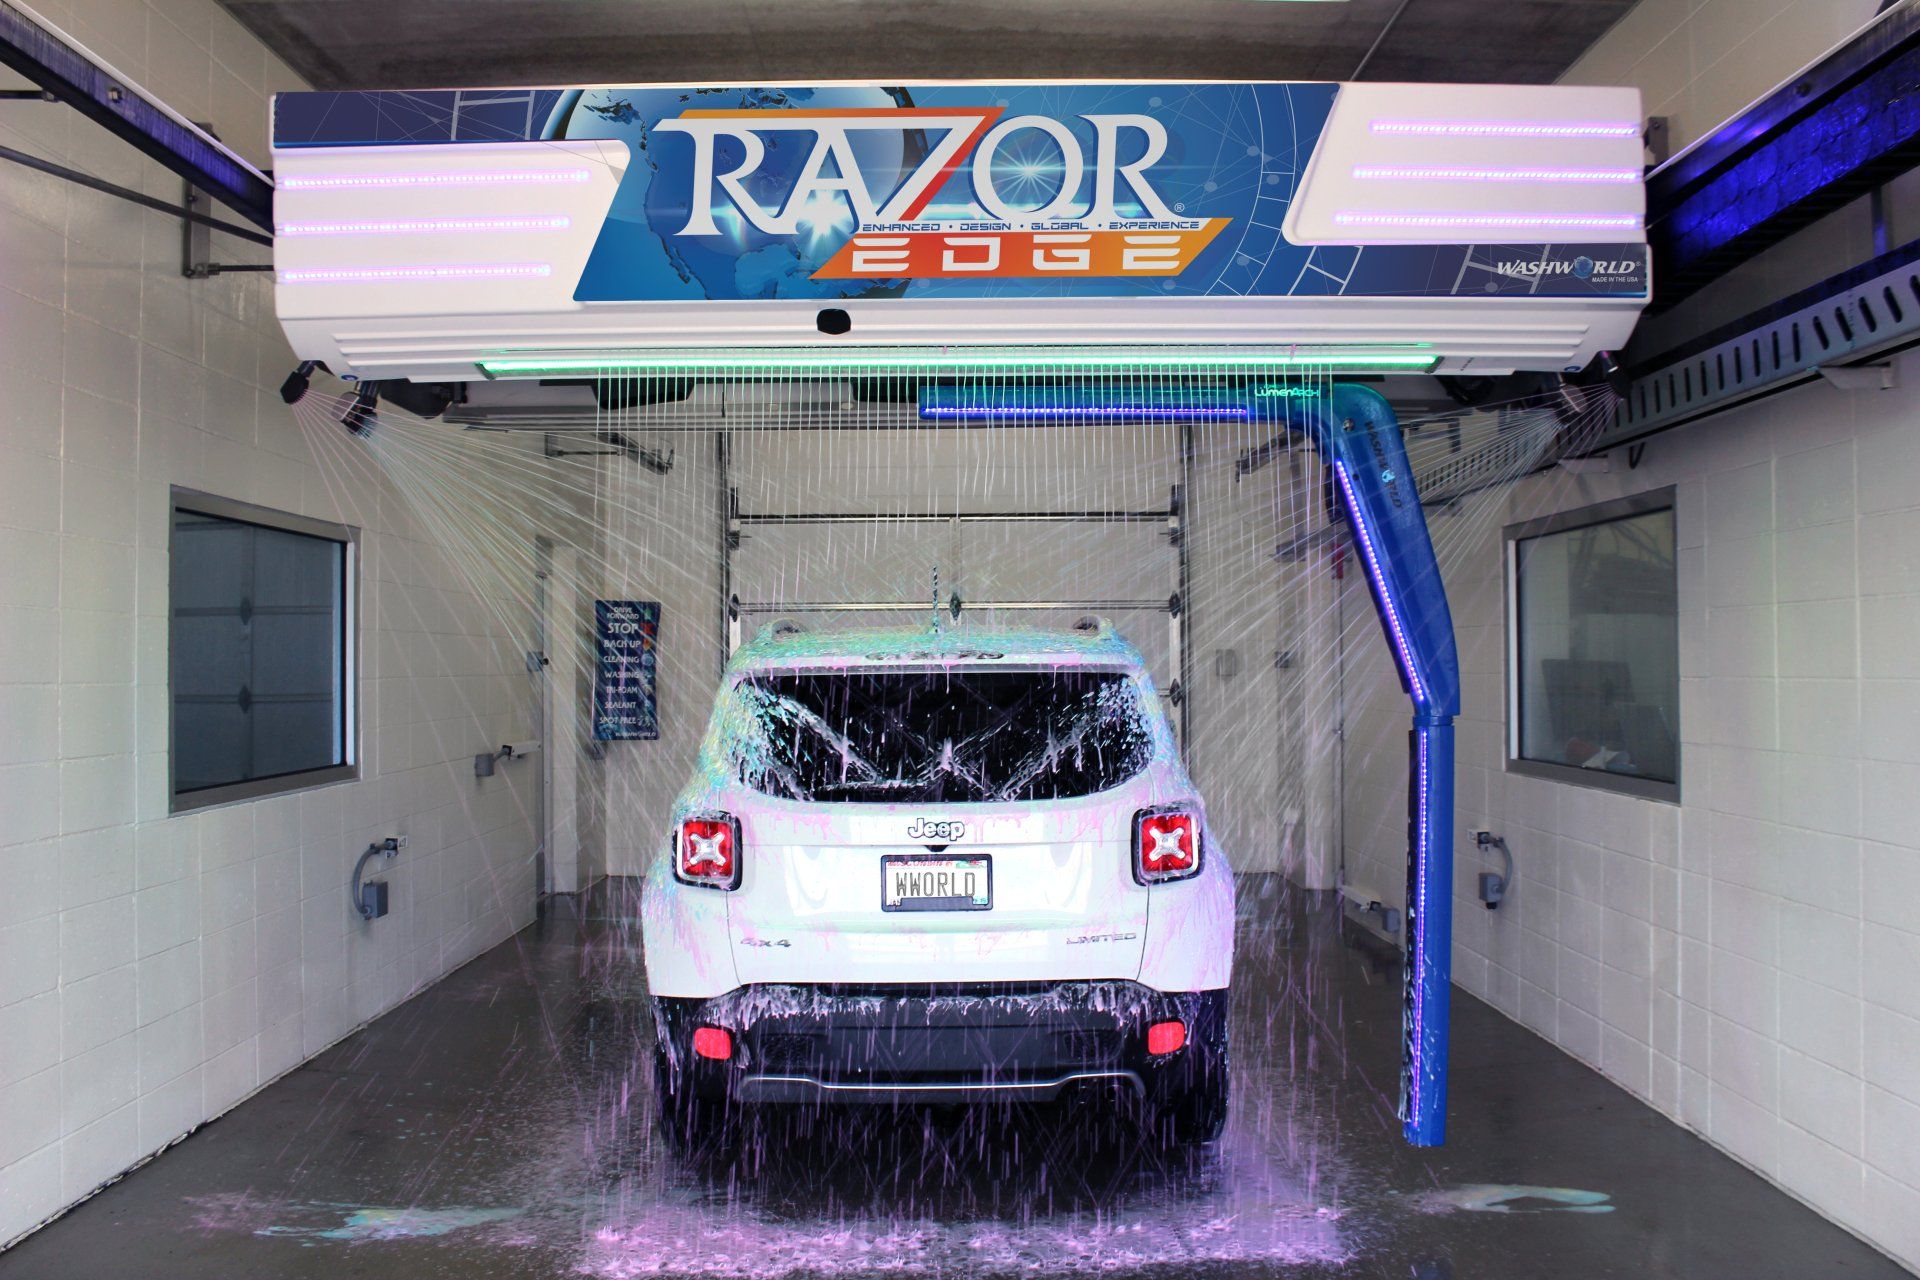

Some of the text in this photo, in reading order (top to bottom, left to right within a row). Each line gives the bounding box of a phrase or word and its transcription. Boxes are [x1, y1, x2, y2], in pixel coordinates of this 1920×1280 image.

[652, 112, 1185, 236] RAZOR
[862, 220, 1200, 232] ENHANCED DESIGN GLOBAL EXPERIENCE
[852, 234, 1181, 272] EDGE
[608, 623, 639, 634] STOP
[604, 640, 641, 648] BACK UP
[605, 671, 639, 679] WASHING
[605, 701, 636, 709] SEALANT
[600, 716, 618, 724] SPOT
[907, 817, 965, 841] Jeep
[895, 872, 976, 897] WWORLD
[1066, 932, 1137, 945] LIMITED
